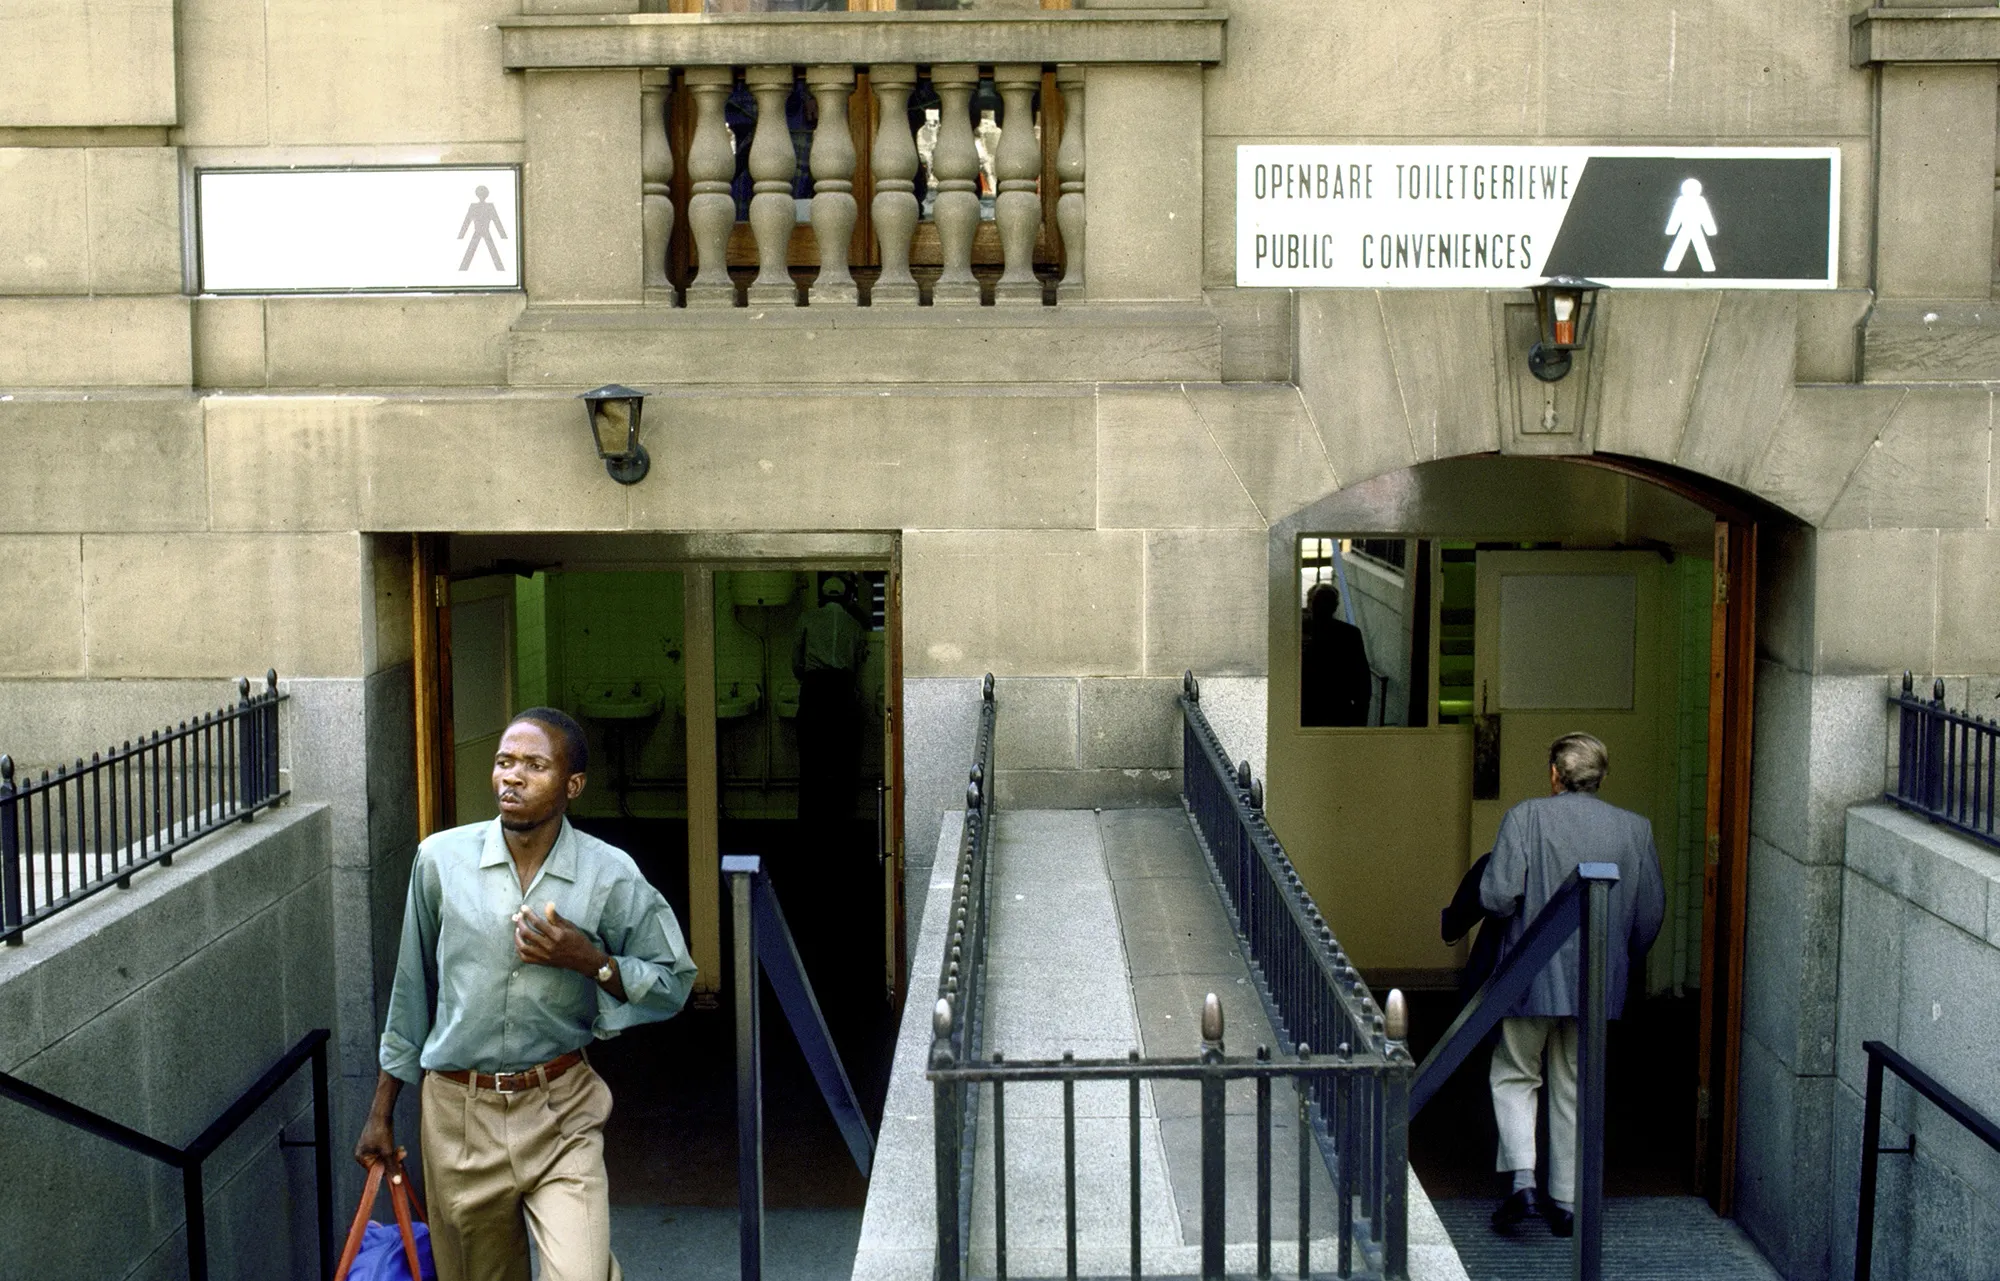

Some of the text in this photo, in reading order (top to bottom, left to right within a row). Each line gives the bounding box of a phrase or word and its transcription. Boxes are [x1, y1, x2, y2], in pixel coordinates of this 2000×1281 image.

[1255, 164, 1569, 200] OPENBARE TOILETGERIEWE
[1255, 233, 1532, 270] PUBLIC CONVENIENCES
